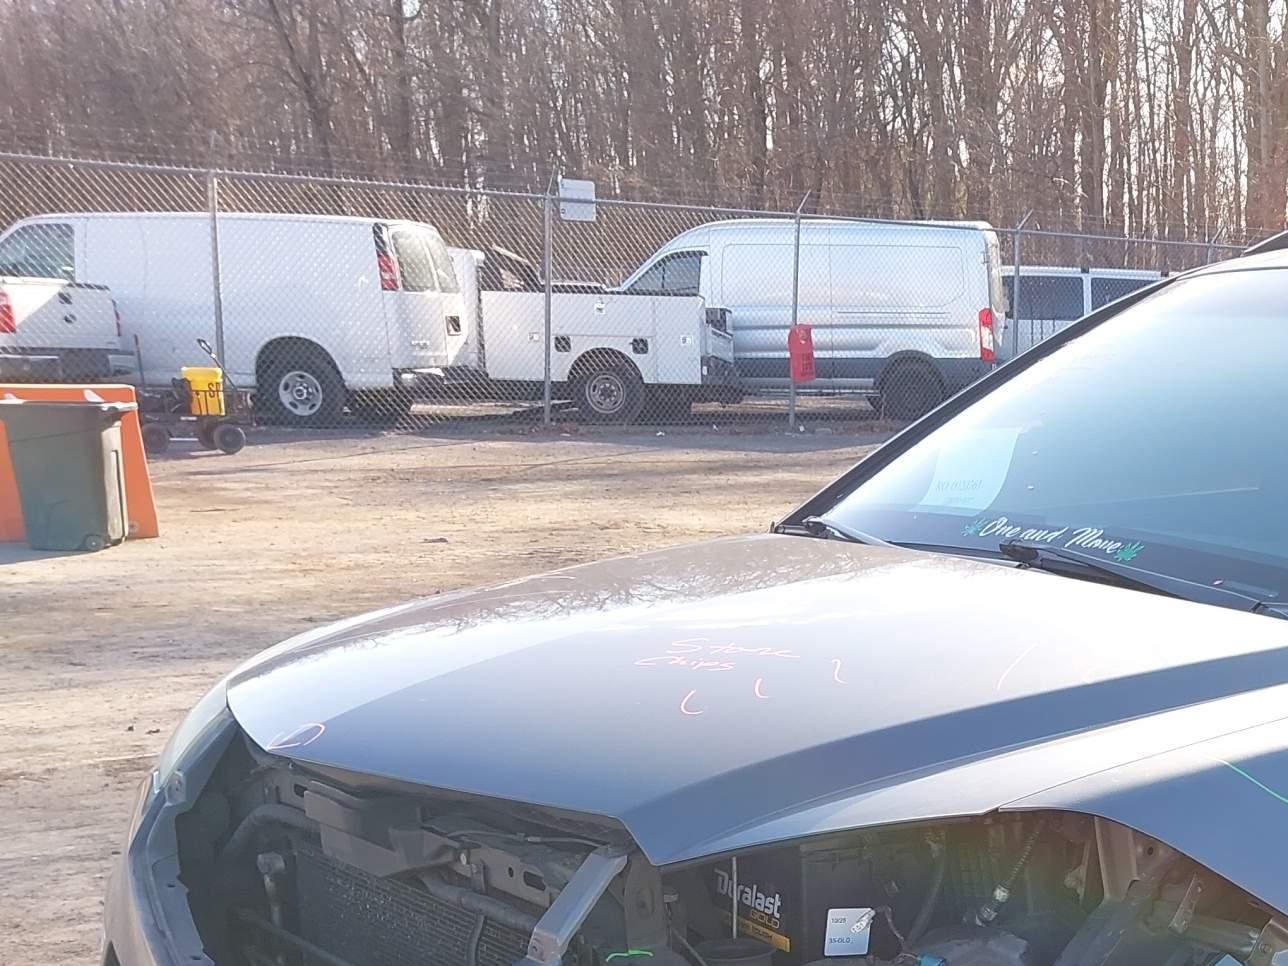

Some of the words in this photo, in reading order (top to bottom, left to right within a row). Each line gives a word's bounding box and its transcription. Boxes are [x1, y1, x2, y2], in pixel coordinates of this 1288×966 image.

[979, 516, 1019, 537] One
[1022, 526, 1070, 543] and
[714, 868, 782, 918] Duralast
[751, 909, 779, 929] GOLD
